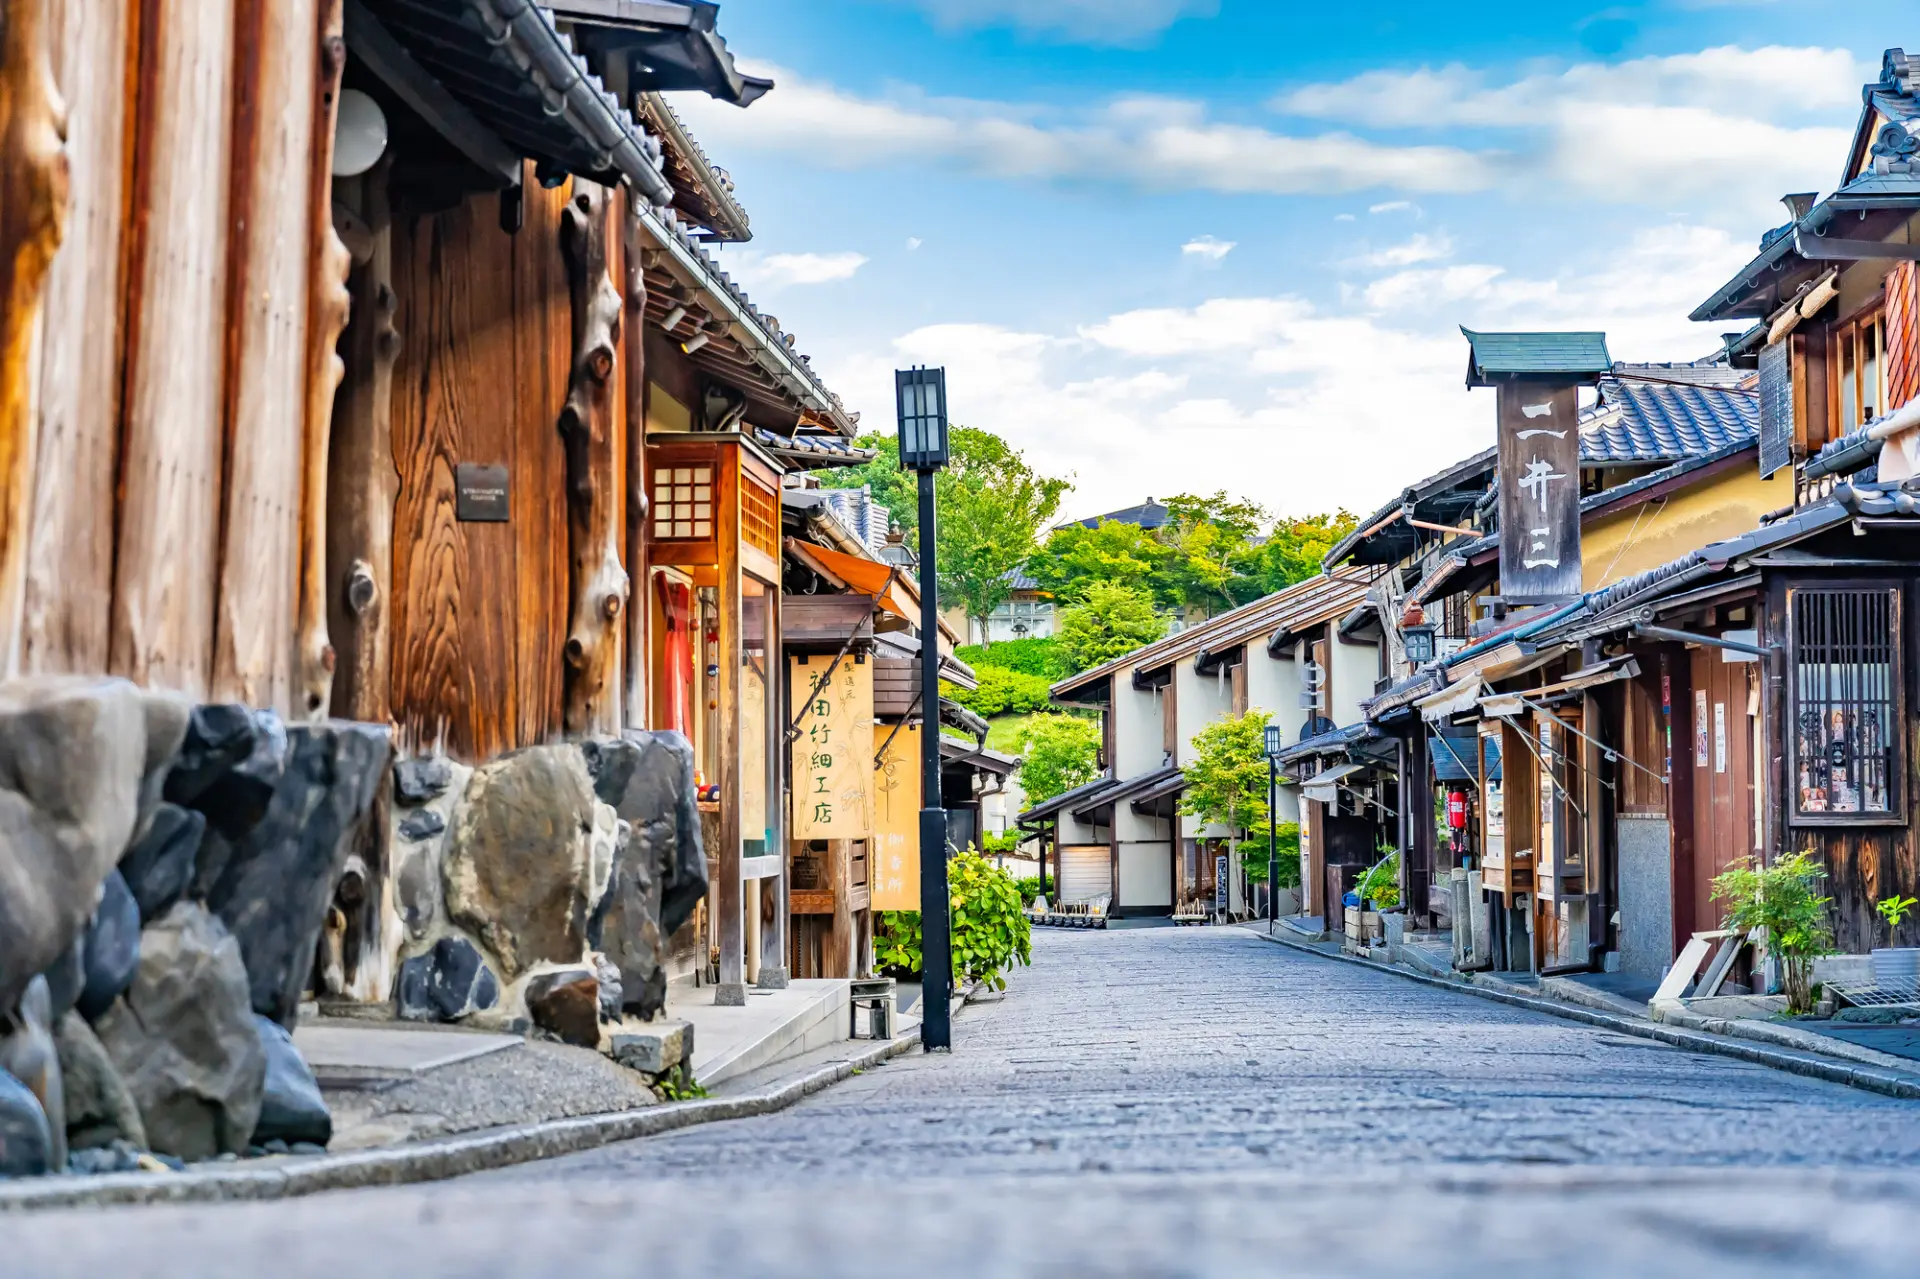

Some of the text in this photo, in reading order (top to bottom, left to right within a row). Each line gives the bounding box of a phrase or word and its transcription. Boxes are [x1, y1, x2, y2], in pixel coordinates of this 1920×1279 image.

[1516, 401, 1568, 569] 二井三
[809, 670, 833, 824] 神田竹細工店
